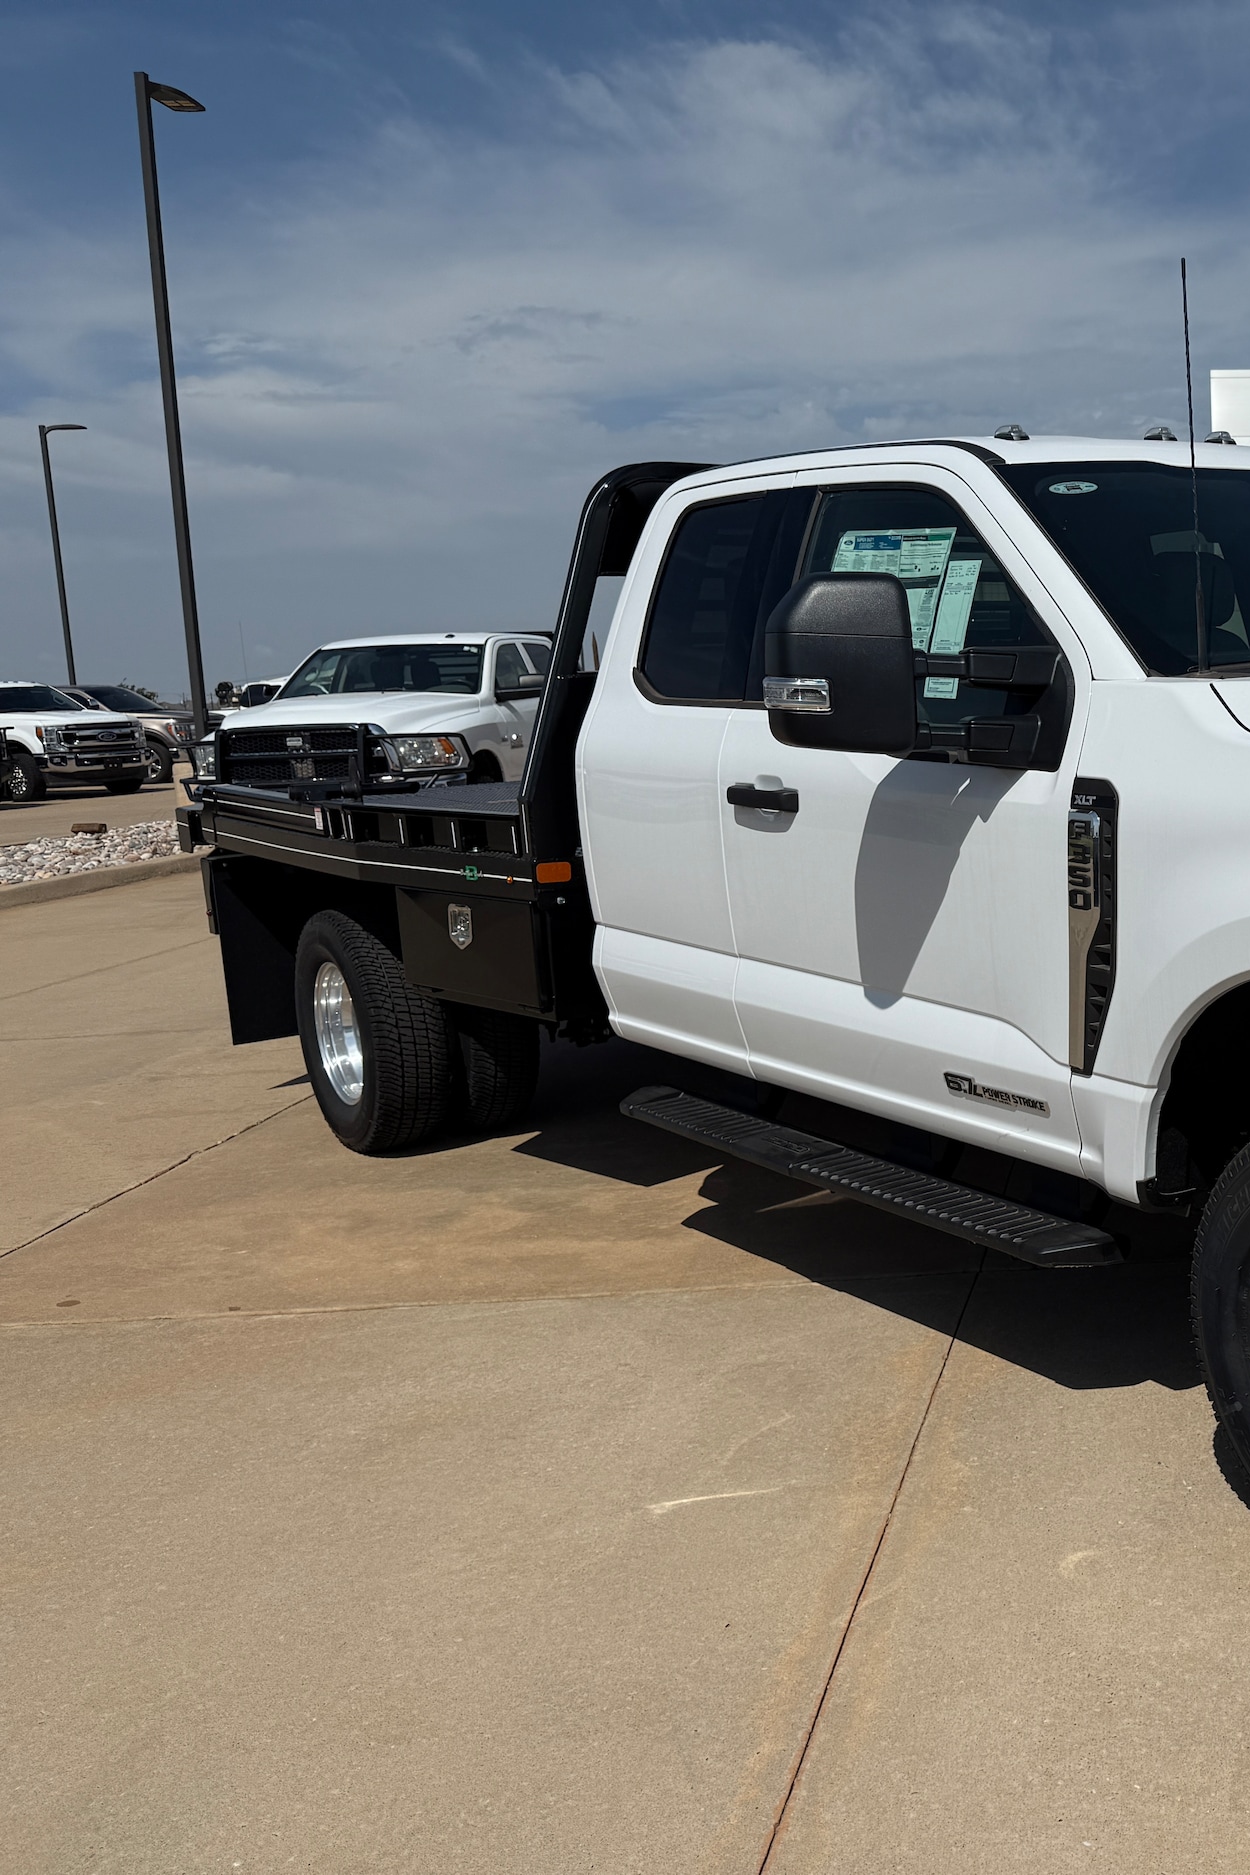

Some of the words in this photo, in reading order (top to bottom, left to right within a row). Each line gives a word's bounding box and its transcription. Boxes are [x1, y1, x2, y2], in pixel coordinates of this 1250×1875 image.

[1073, 794, 1096, 806] XLT
[982, 1086, 1012, 1103] POWER
[1011, 1094, 1046, 1112] STROKE
